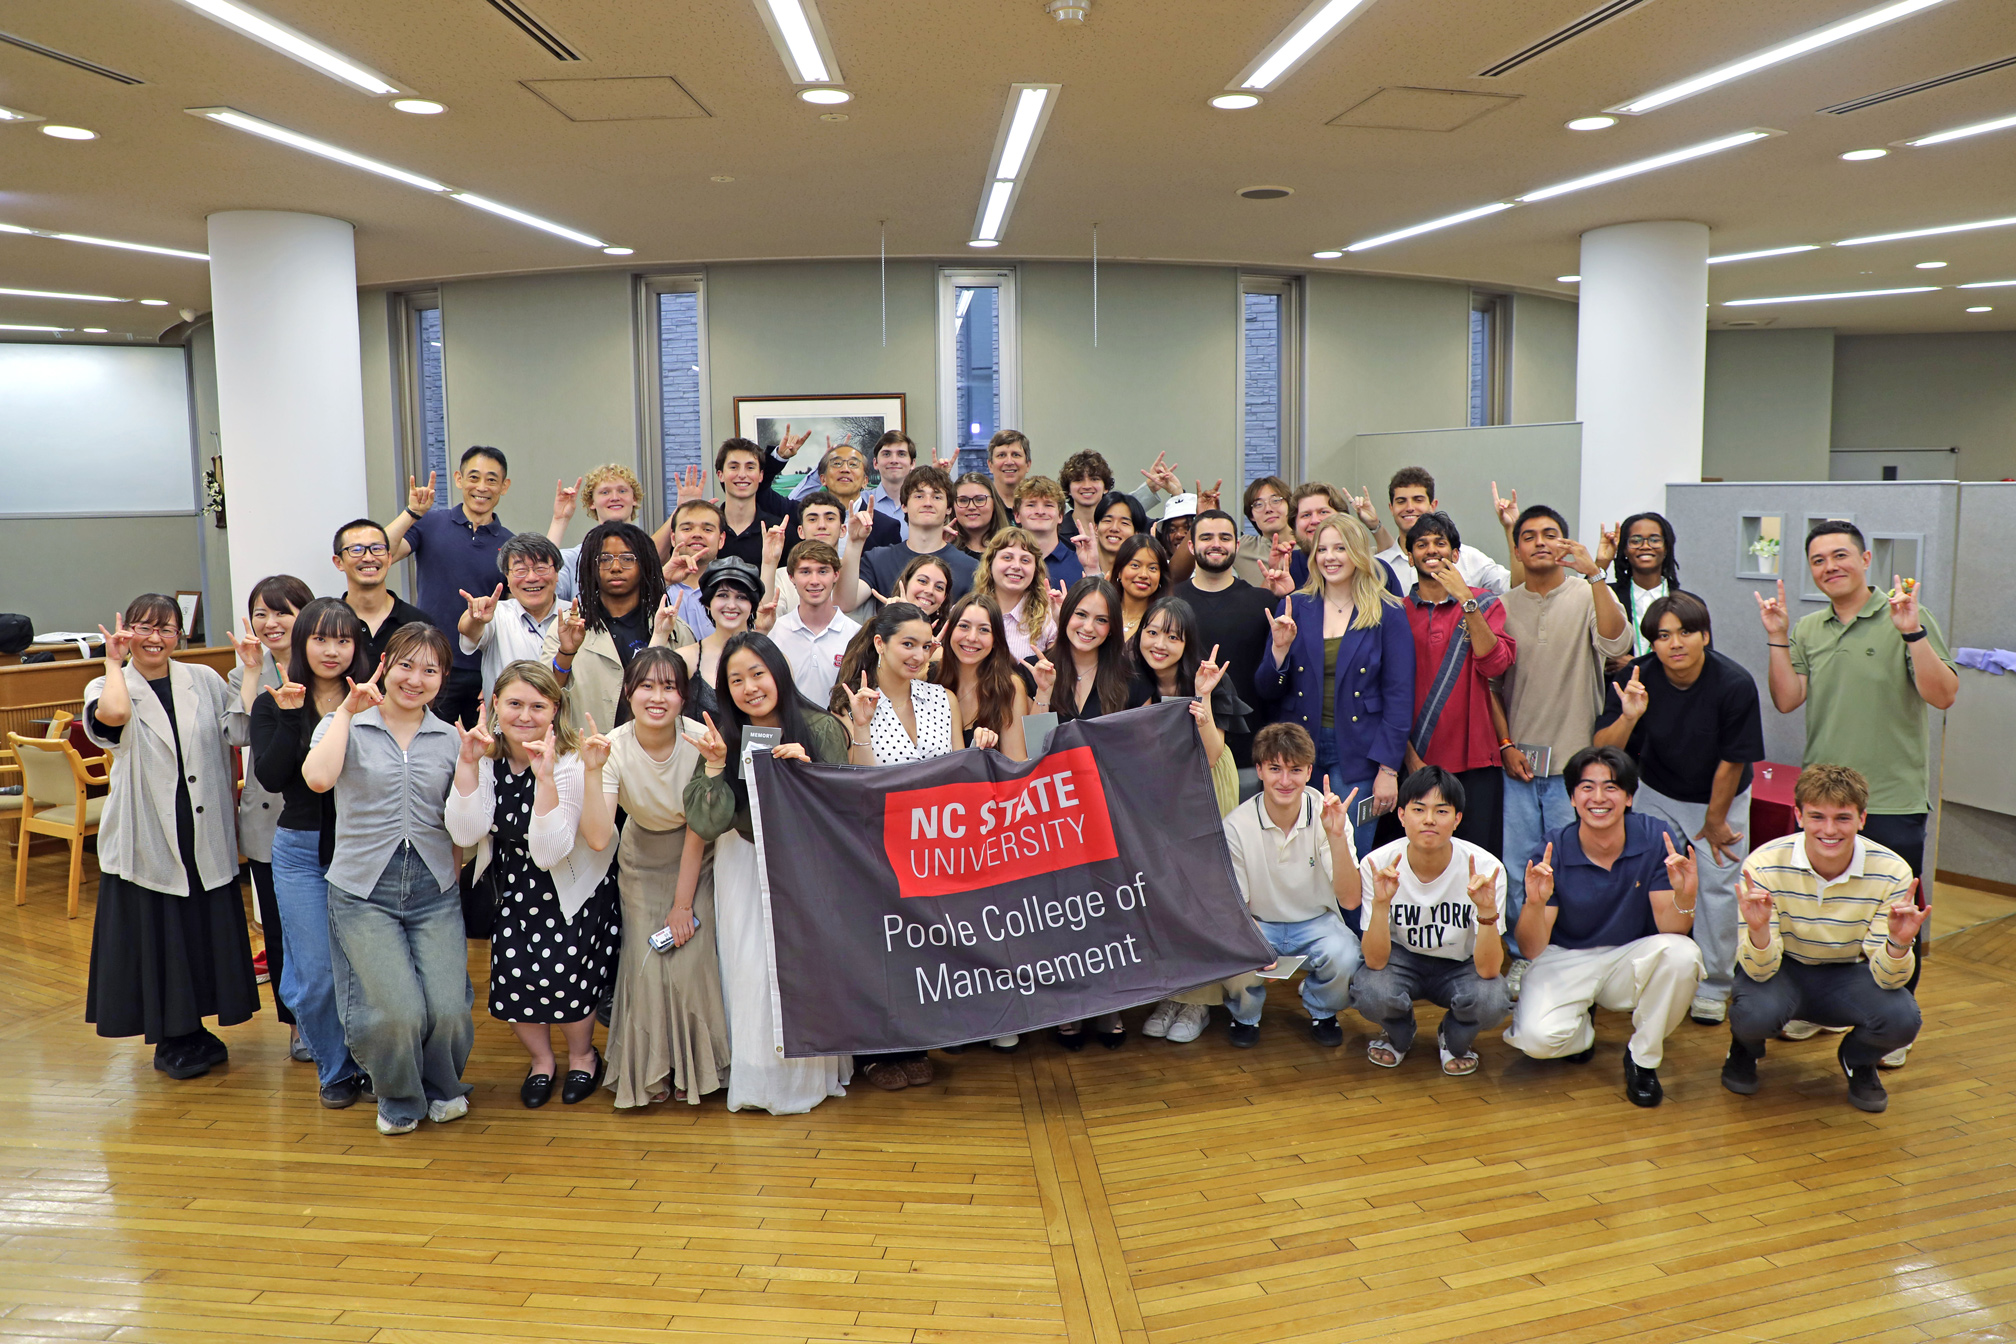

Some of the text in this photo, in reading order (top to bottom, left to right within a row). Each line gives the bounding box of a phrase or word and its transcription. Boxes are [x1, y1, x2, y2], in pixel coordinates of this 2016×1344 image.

[910, 770, 1080, 839] NC STATE
[910, 813, 1085, 878] UNIVERSITY
[883, 871, 1147, 952] Poole College of
[1407, 924, 1445, 948] CITY
[1430, 902, 1472, 928] YORK
[915, 933, 1142, 1004] Management
